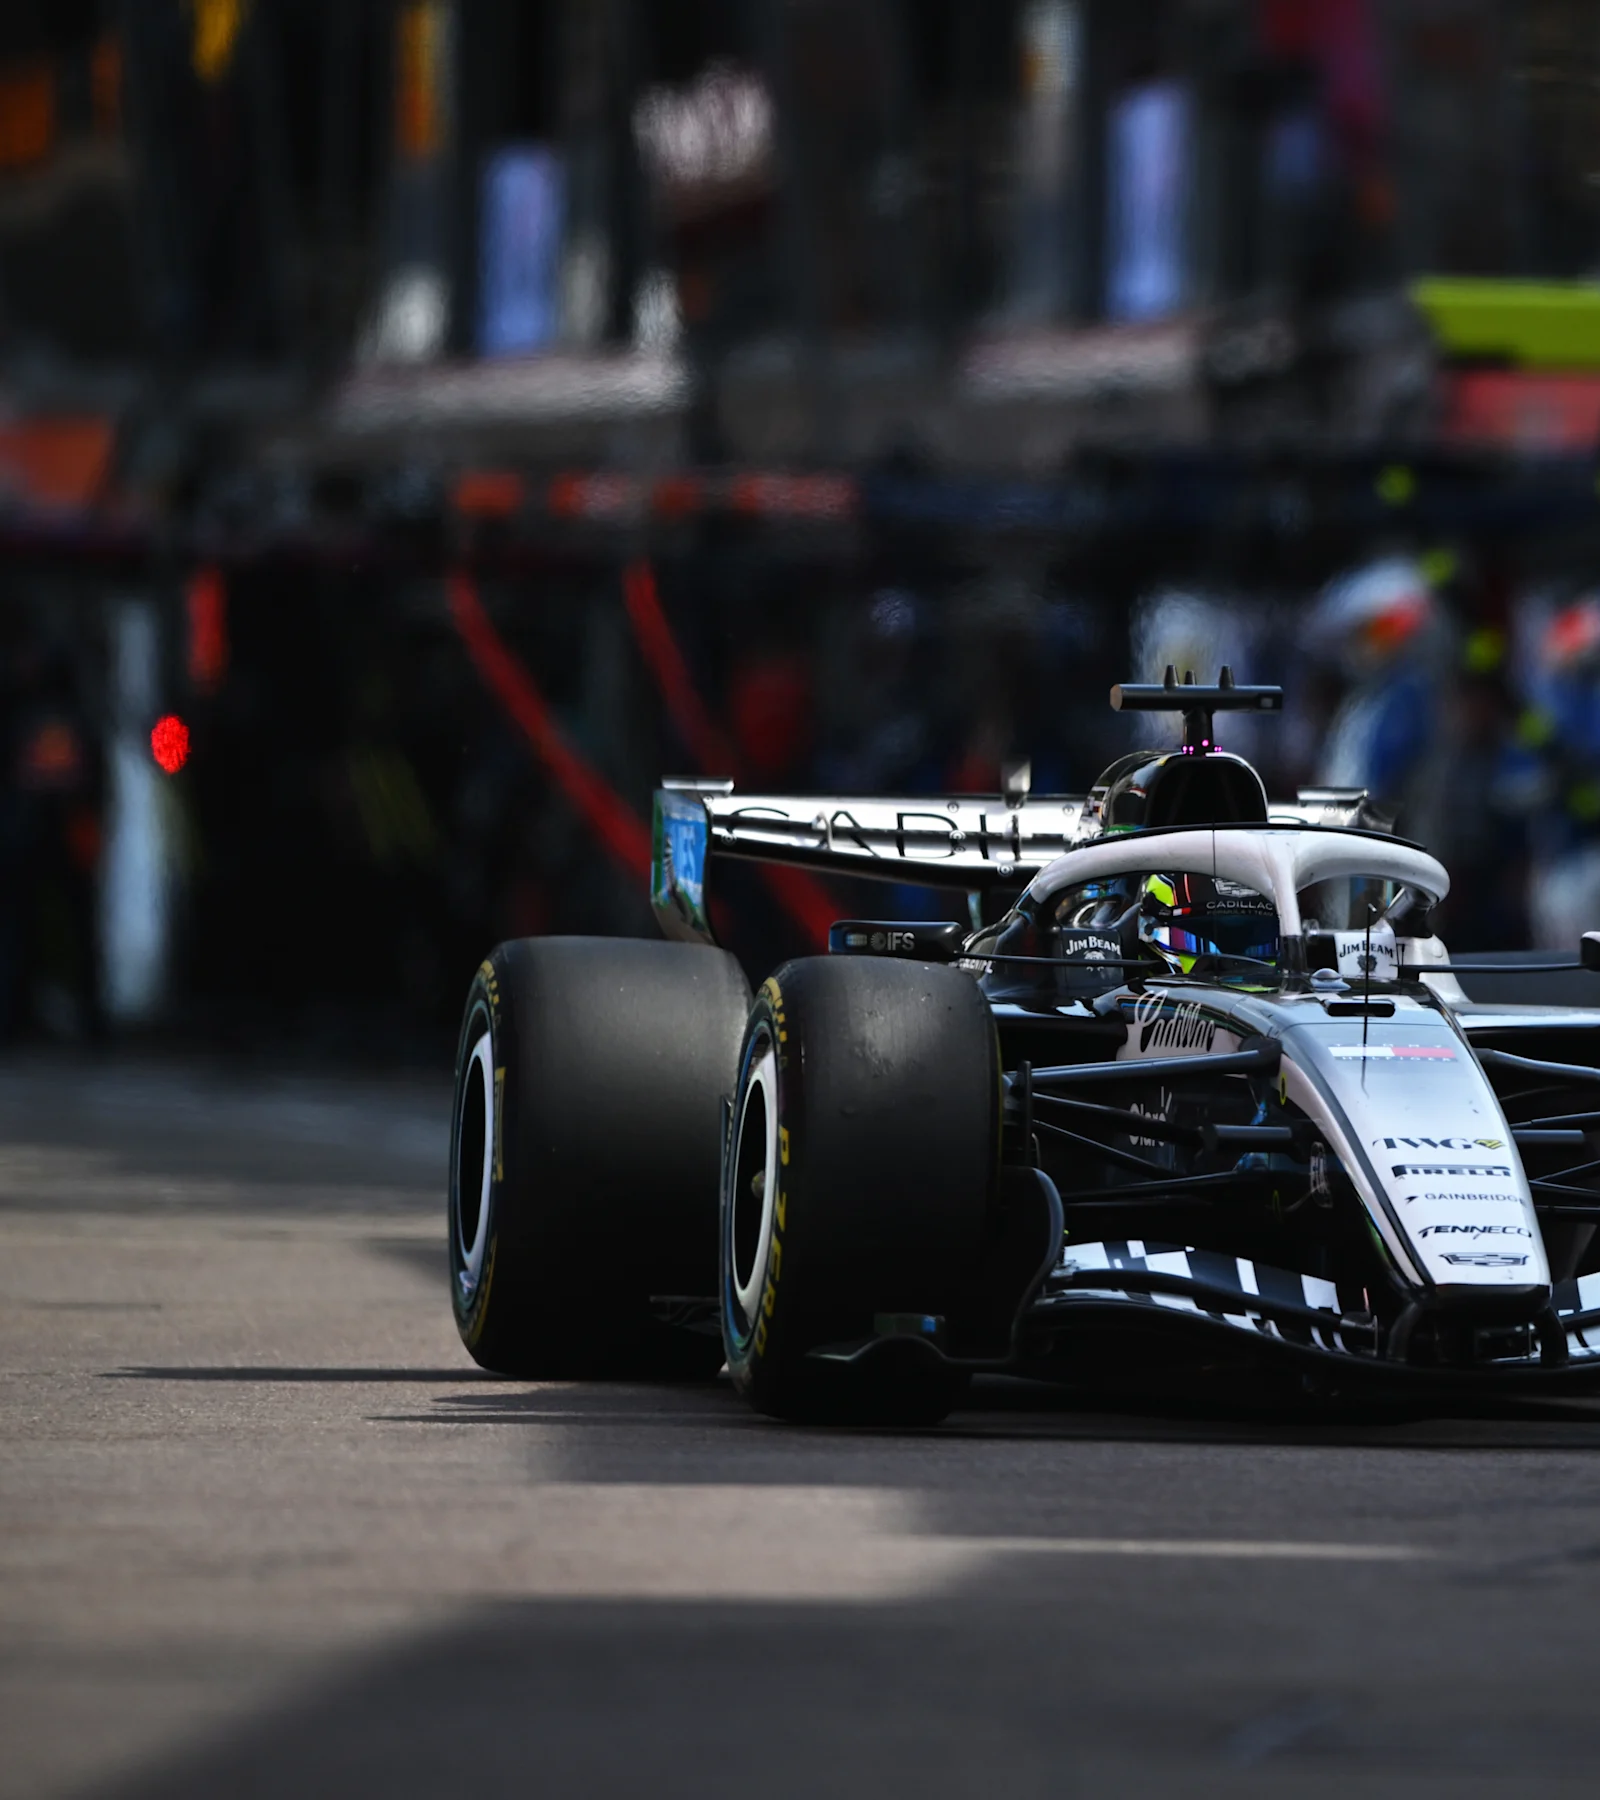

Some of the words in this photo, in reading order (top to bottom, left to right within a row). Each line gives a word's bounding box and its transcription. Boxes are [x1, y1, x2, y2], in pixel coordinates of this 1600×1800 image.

[1206, 900, 1273, 911] CADILLAC
[887, 932, 915, 951] IFS
[1065, 939, 1088, 955] JIM
[1088, 935, 1121, 956] BEAM
[1339, 943, 1360, 958] JIM
[1362, 939, 1394, 958] BEAM
[1134, 989, 1216, 1053] Cadillac
[1372, 1138, 1472, 1149] TWG
[1391, 1164, 1511, 1178] PIRELLI
[1418, 1225, 1532, 1239] TENNECO
